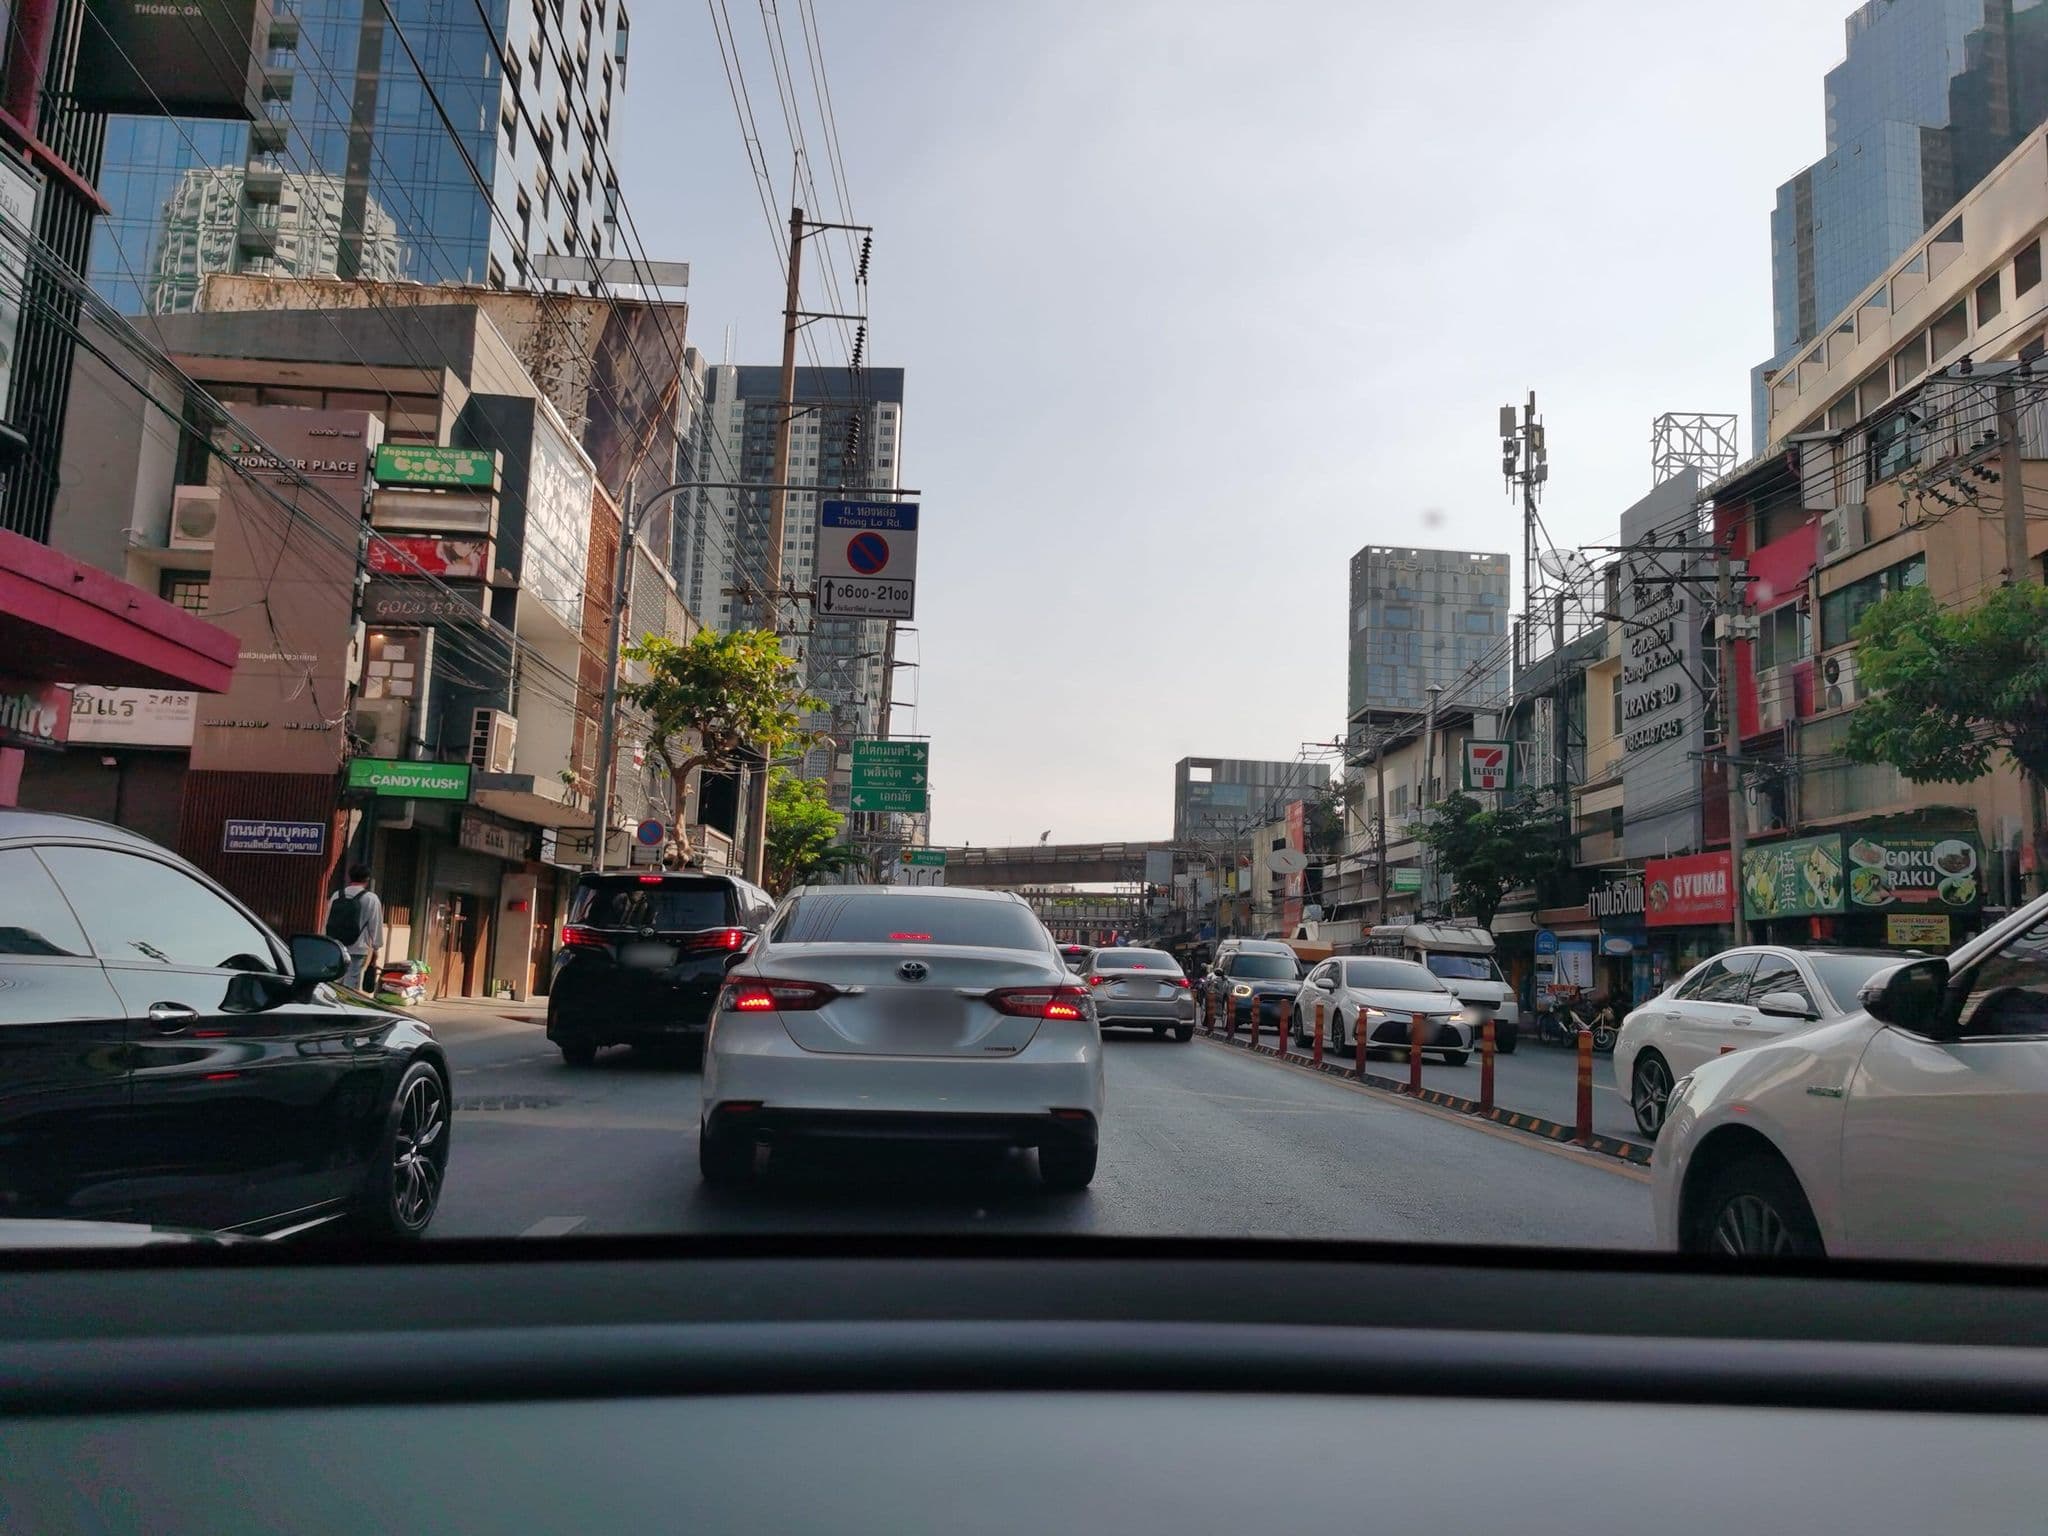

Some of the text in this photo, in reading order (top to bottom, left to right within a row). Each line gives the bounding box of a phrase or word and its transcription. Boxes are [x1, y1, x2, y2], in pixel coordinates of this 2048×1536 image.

[134, 4, 202, 16] THONGOR
[313, 459, 357, 472] PLACE
[838, 516, 867, 528] Thong
[870, 519, 883, 527] Lo
[1624, 682, 1676, 719] XRAYS 3D
[1472, 748, 1504, 788] 7
[371, 775, 420, 788] CANDY
[230, 823, 319, 842] ถนนส่วนบุคคล
[1886, 851, 1935, 867] GOKU
[1674, 870, 1728, 898] GYUMA
[1887, 871, 1936, 886] RAKU
